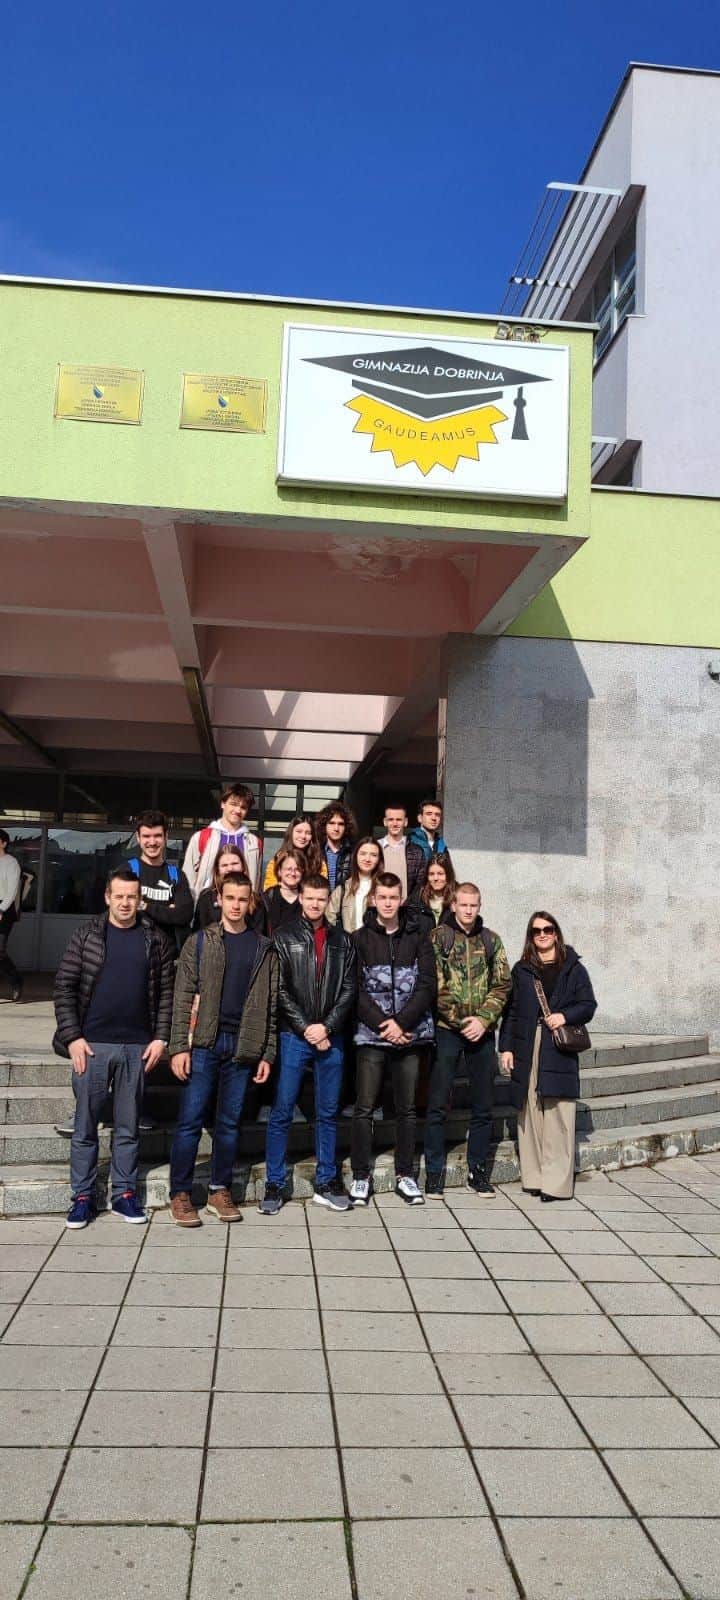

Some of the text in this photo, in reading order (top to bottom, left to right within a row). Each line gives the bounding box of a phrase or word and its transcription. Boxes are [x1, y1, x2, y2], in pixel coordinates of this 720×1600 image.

[352, 358, 504, 381] GIMNAZIJA DOBRINJA
[373, 418, 476, 441] GAUDEAMUS
